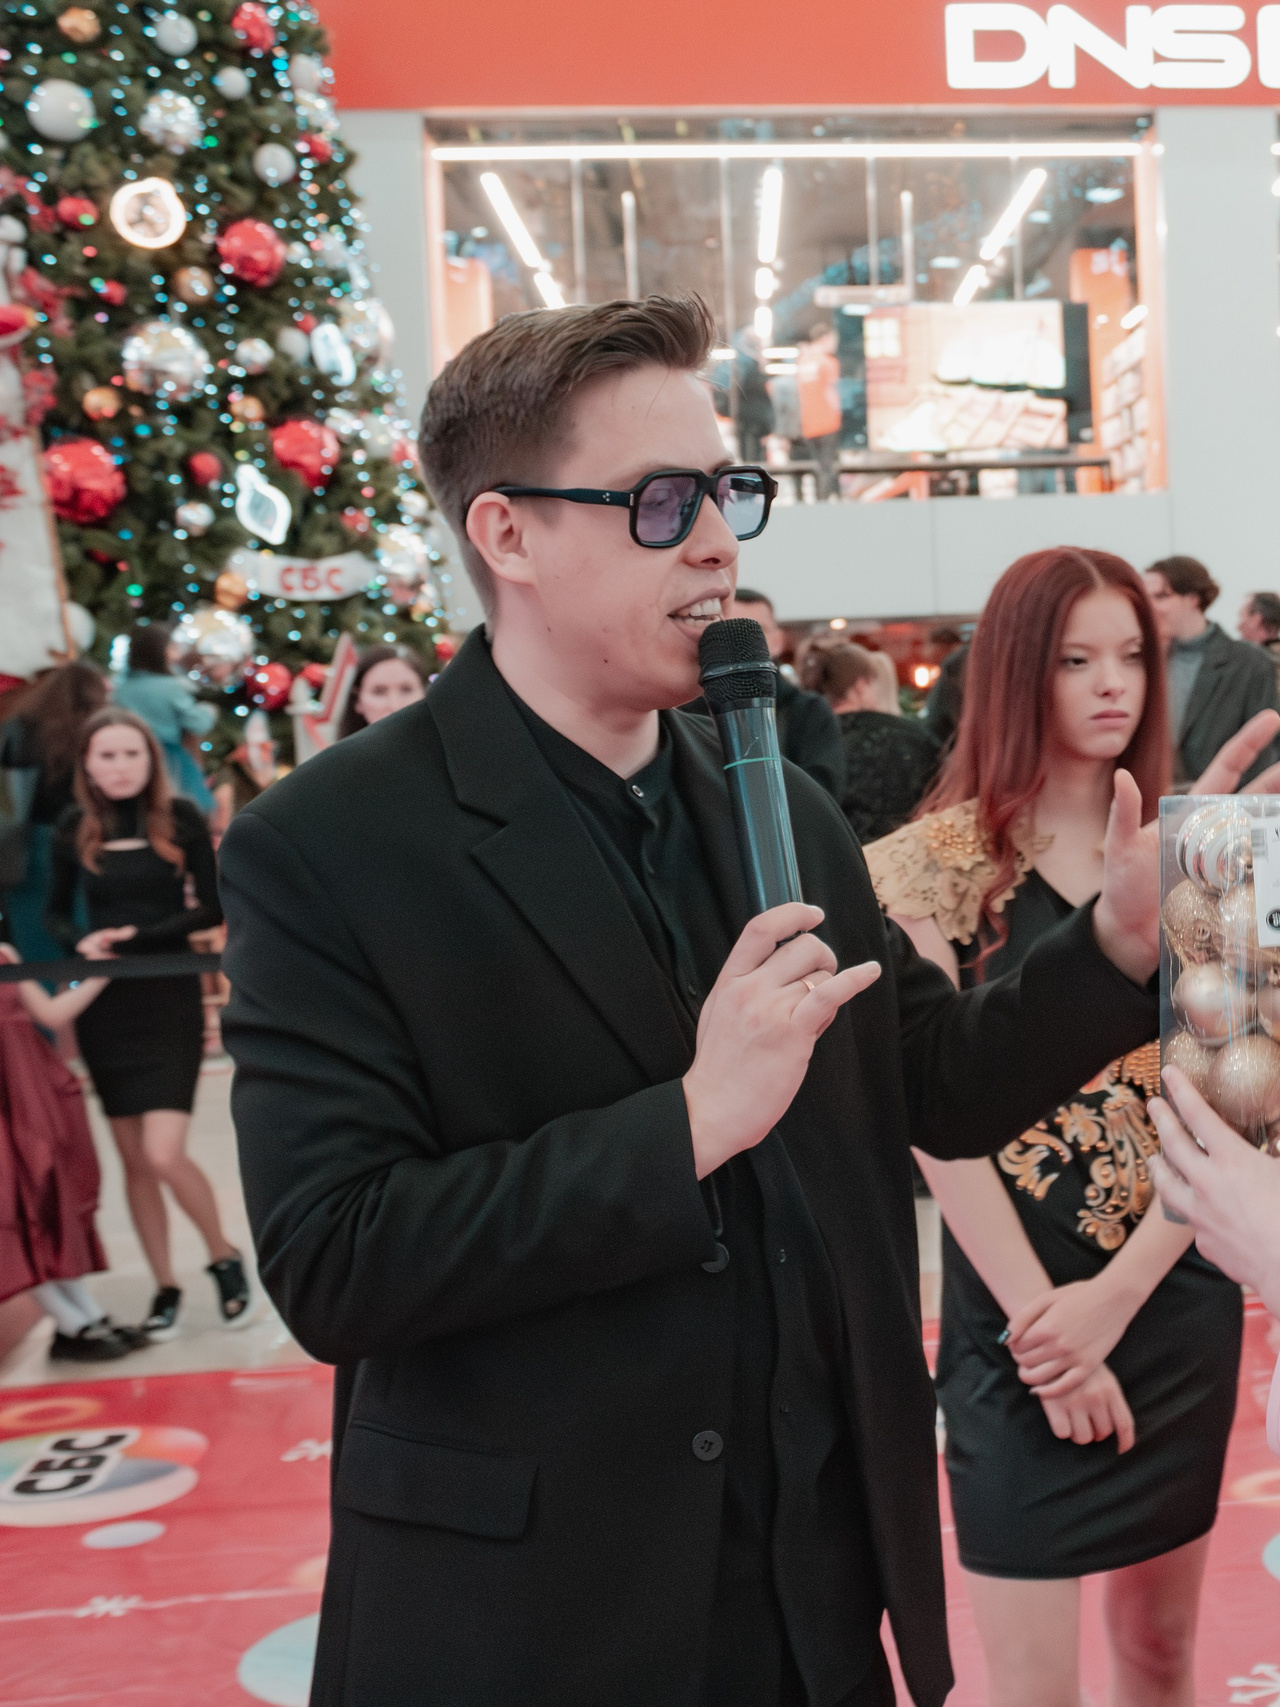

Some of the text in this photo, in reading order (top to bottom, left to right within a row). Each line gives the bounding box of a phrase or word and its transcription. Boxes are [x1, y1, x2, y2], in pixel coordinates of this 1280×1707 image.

[945, 3, 1252, 89] DNS
[279, 565, 343, 594] СБС
[13, 1434, 128, 1494] СБС
